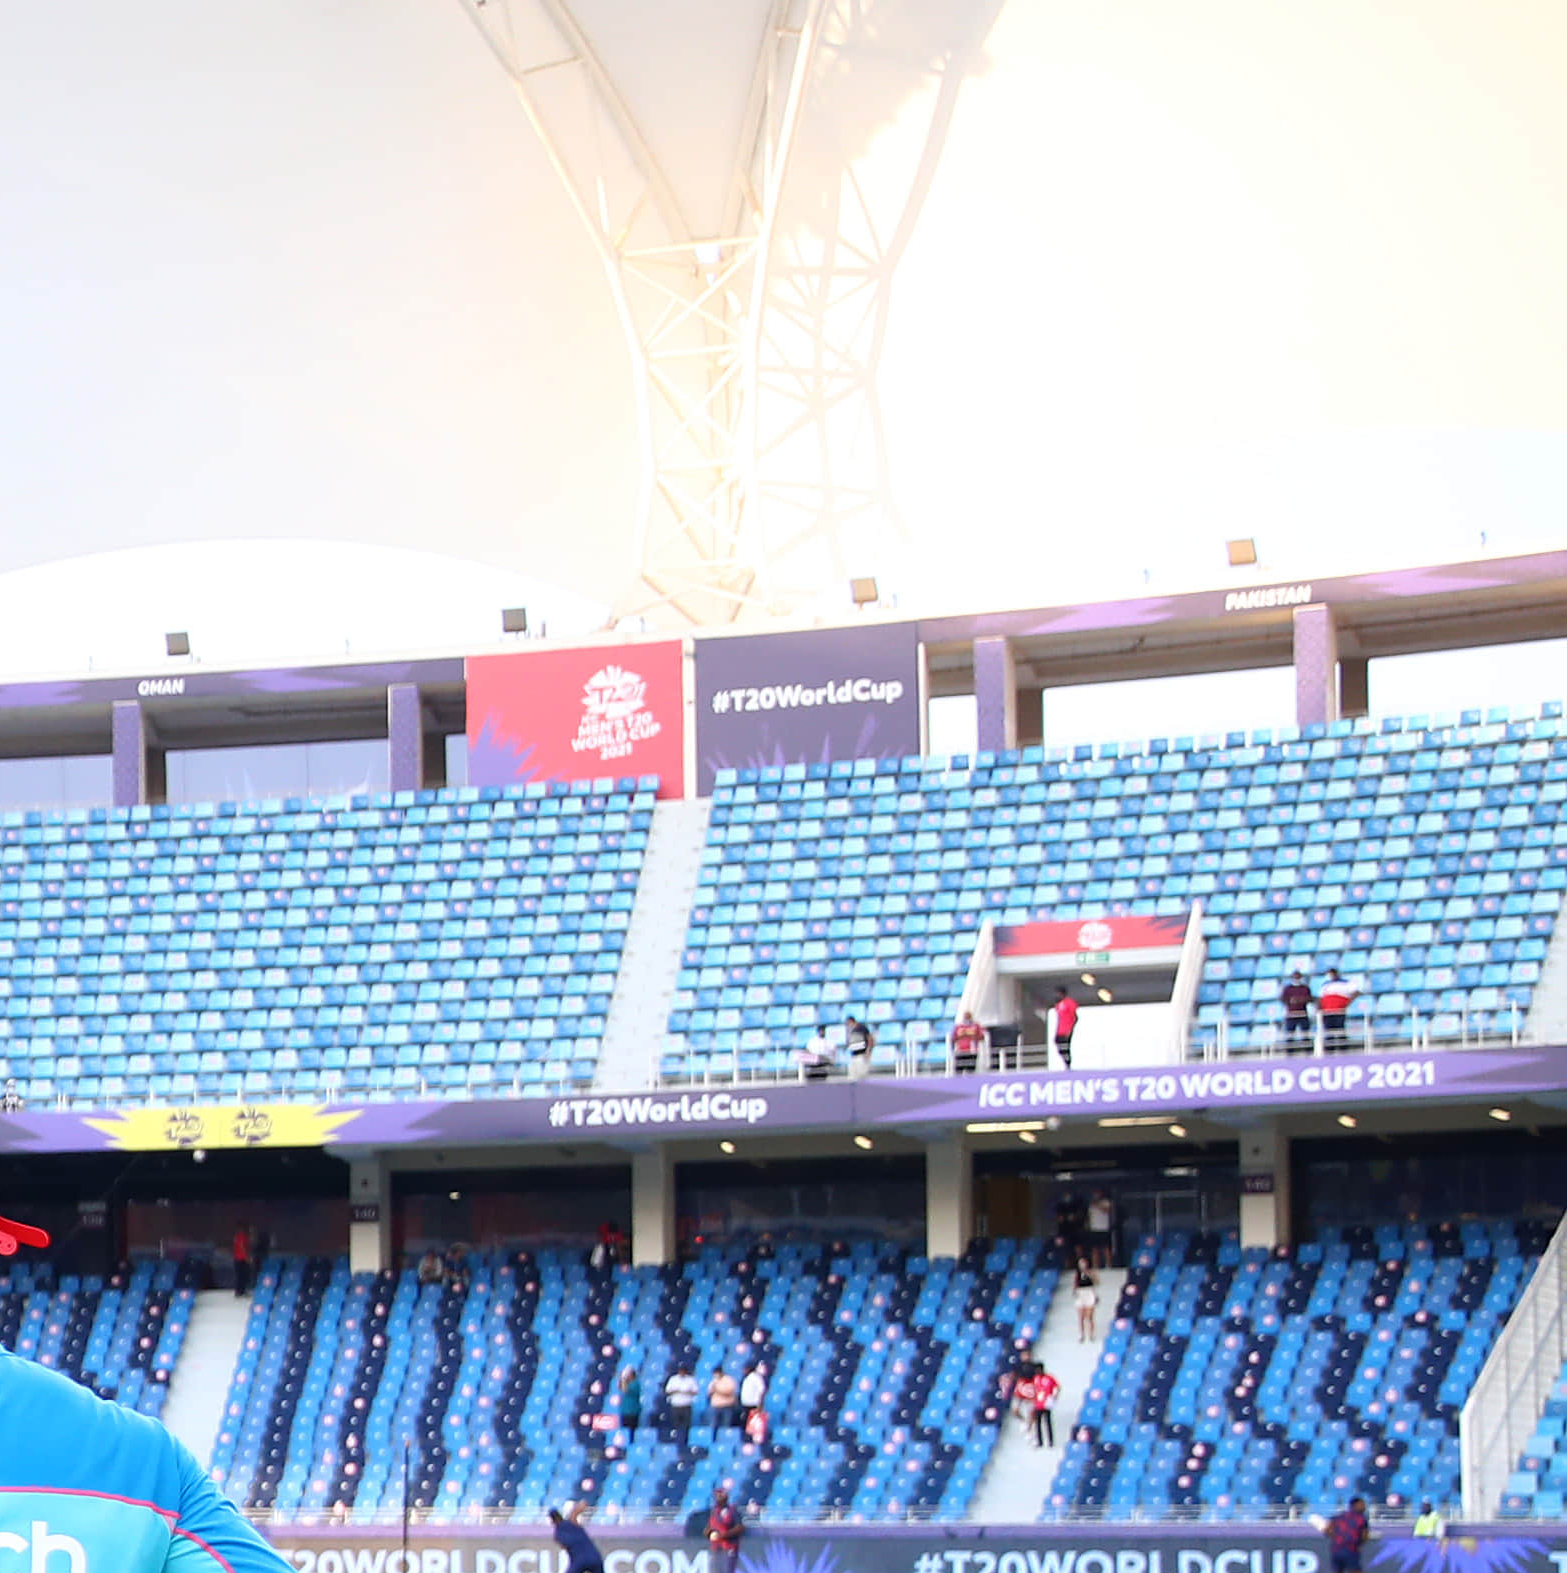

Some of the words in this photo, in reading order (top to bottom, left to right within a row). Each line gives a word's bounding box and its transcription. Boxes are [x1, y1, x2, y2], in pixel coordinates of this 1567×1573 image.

[1225, 584, 1311, 611] PAKISTAN
[137, 678, 185, 696] OMAN
[713, 676, 903, 712] #T20WorldCup
[571, 729, 628, 752] WORLD
[629, 721, 661, 741] CUP
[978, 1083, 1027, 1108] ICC
[1029, 1079, 1120, 1105] MEN'S
[1123, 1076, 1172, 1101] T20
[1180, 1069, 1295, 1099] WORLD
[1298, 1065, 1363, 1093] CUP
[1368, 1060, 1436, 1088] 2021
[549, 1093, 767, 1127] #T20WorldCup
